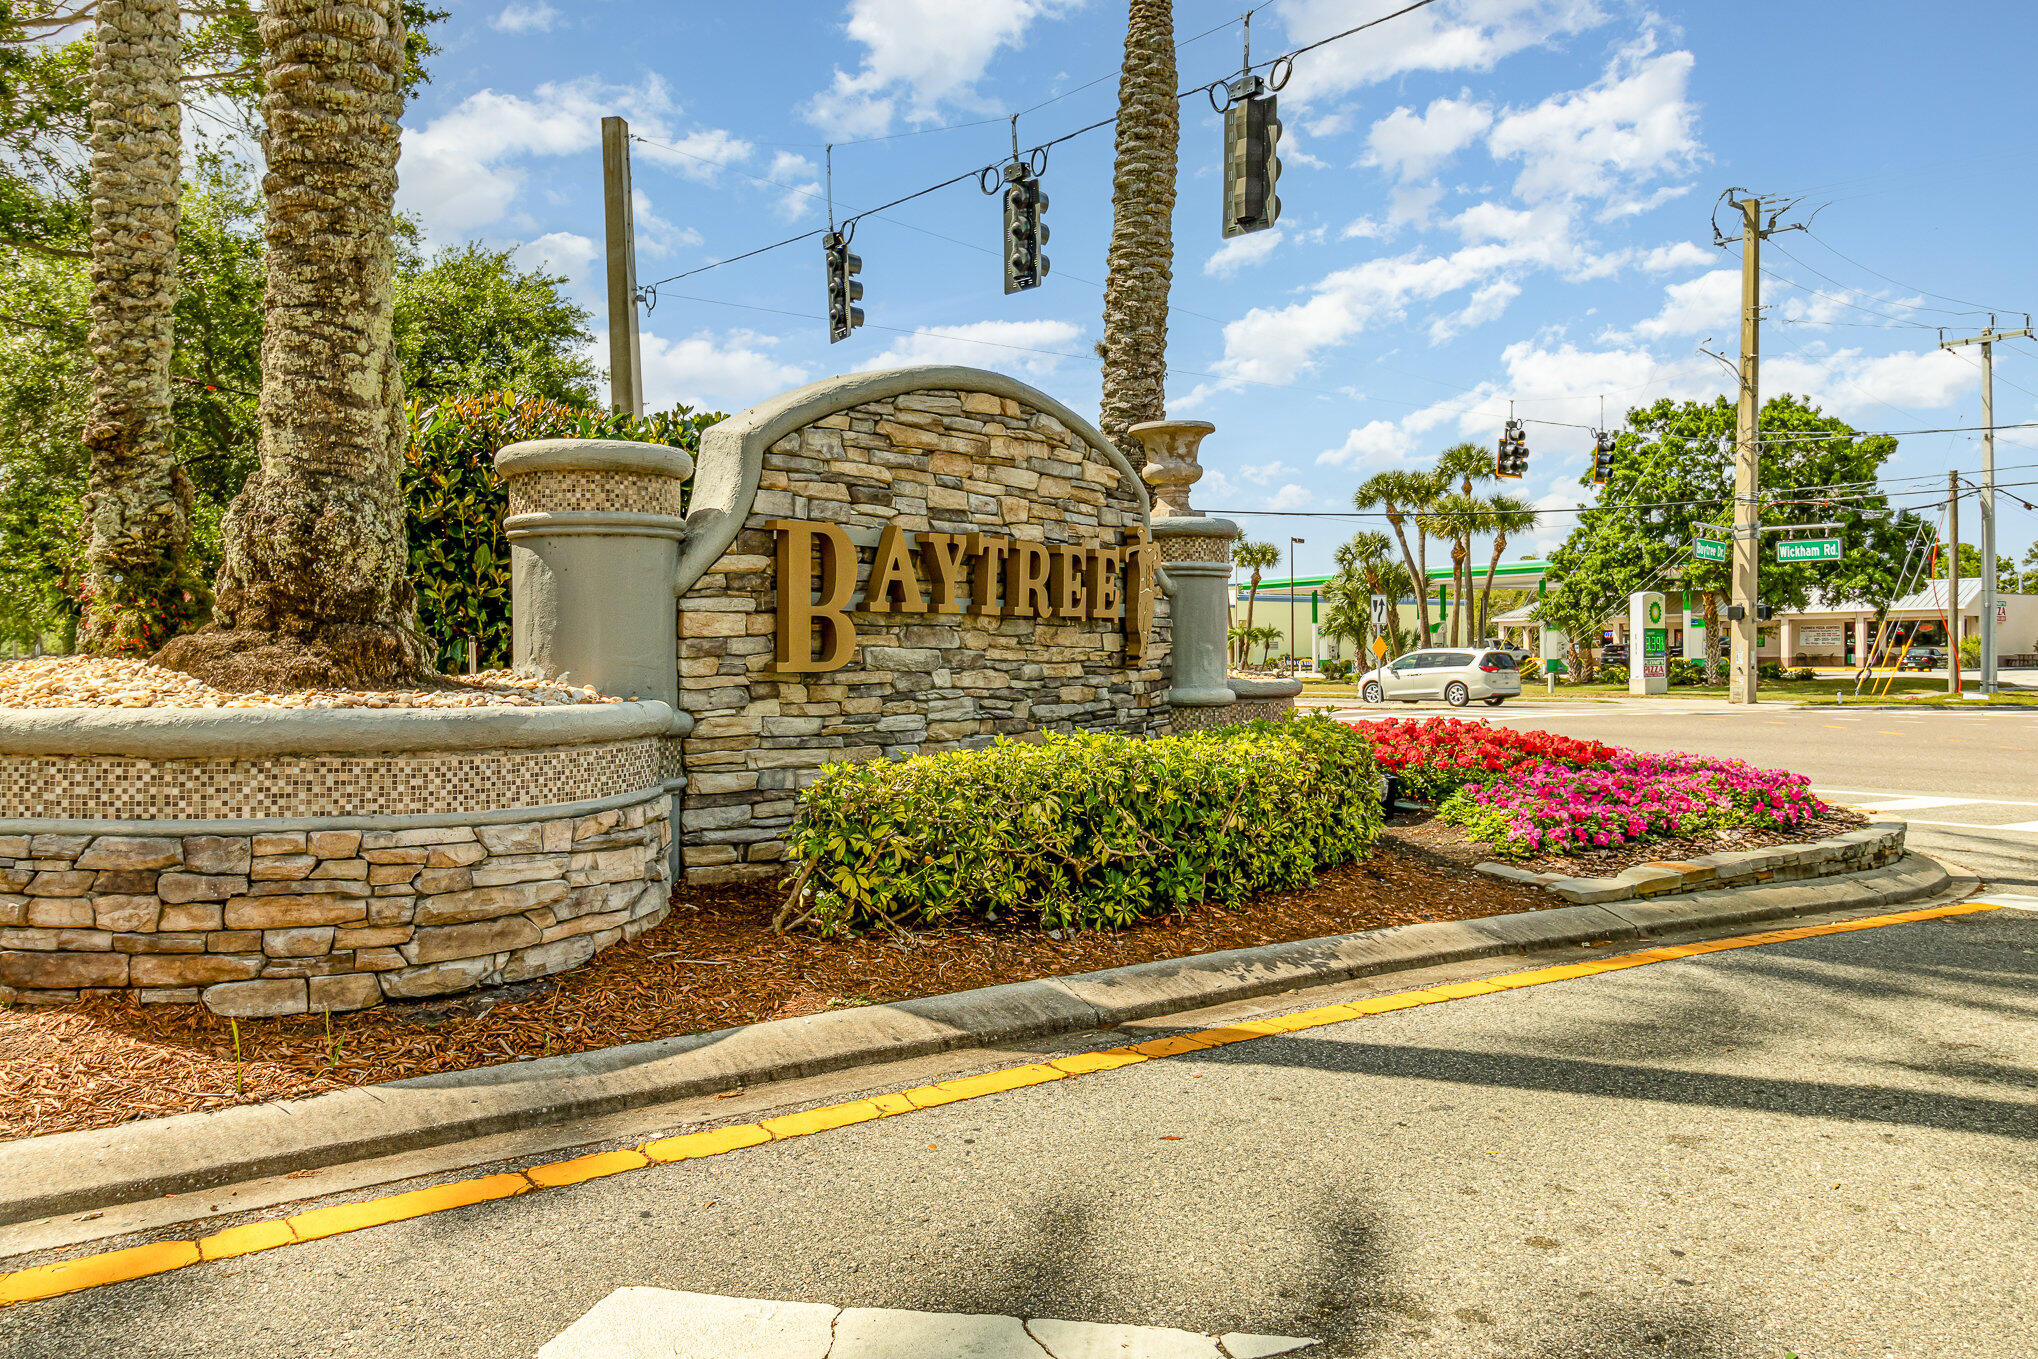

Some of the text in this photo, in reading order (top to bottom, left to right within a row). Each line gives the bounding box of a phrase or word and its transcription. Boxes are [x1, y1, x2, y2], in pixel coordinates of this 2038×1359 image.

[1779, 543, 1839, 557] Wickham Rd.
[765, 519, 1120, 673] BAYTREE
[1643, 665, 1664, 674] PIZZA
